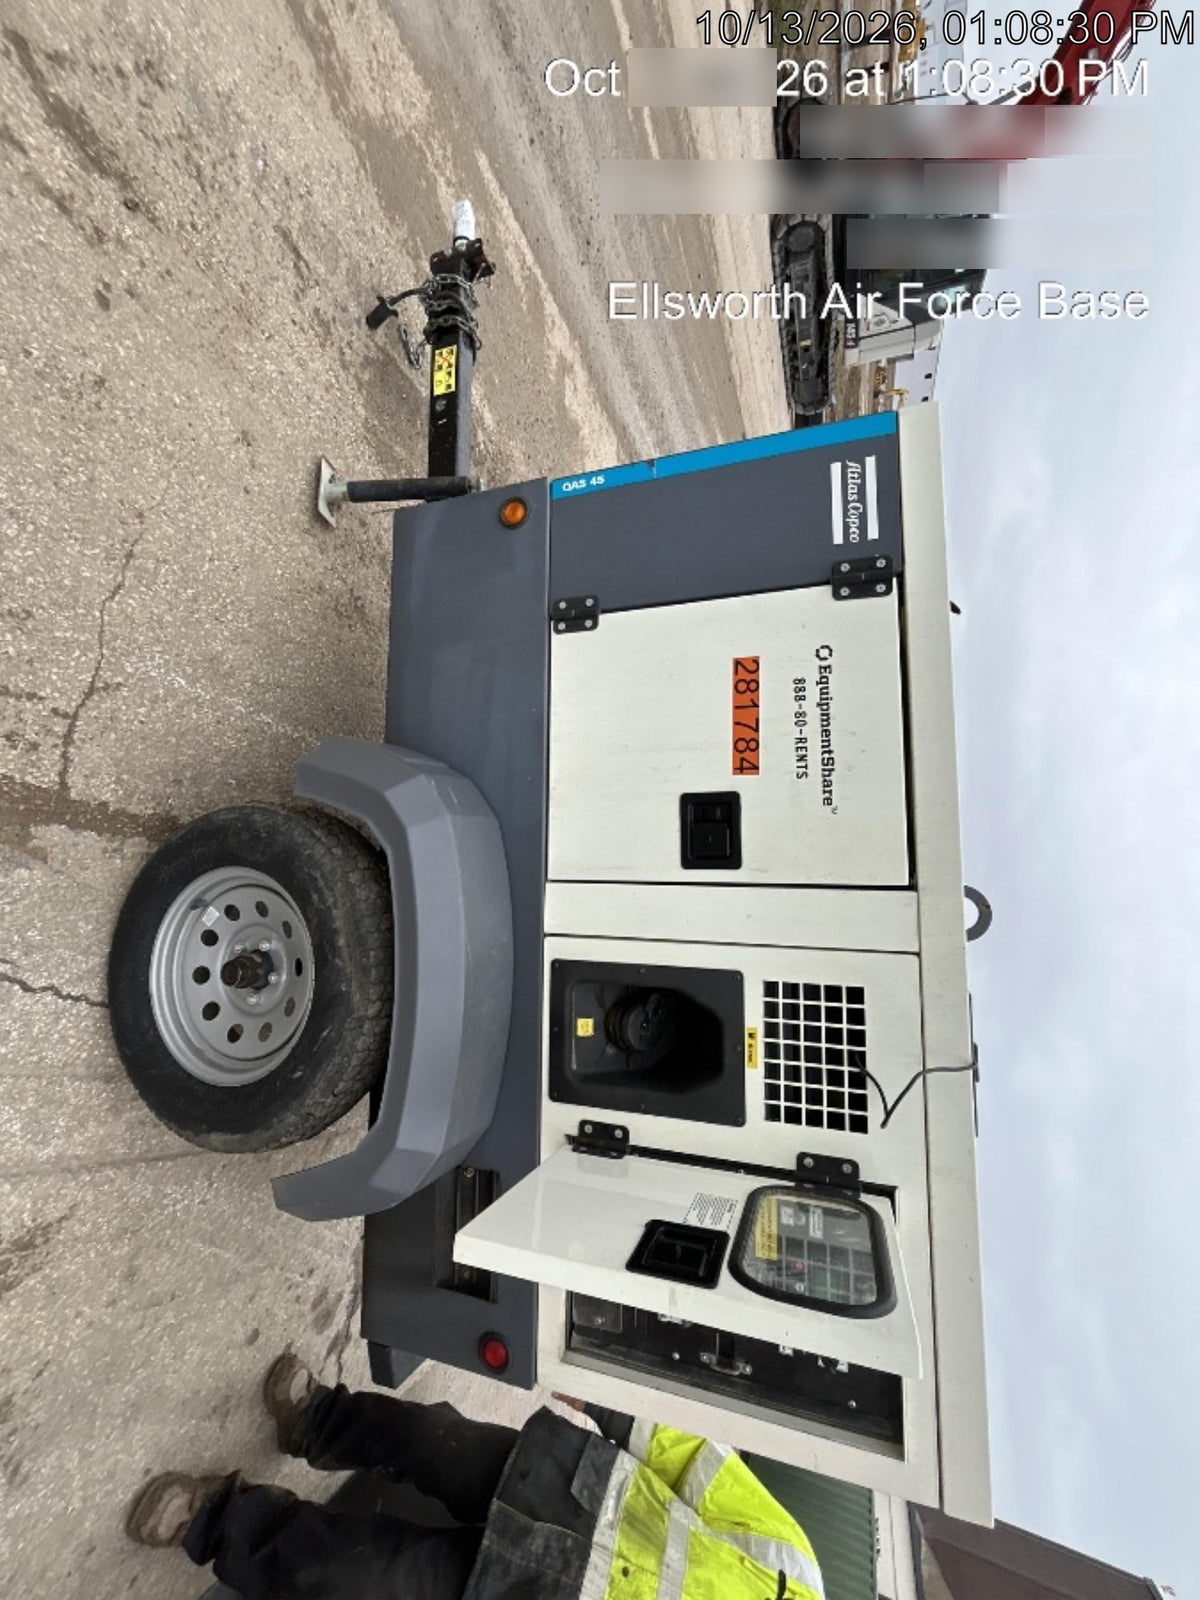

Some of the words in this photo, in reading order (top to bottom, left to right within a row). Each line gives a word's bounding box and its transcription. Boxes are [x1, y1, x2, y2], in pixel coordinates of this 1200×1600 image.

[845, 460, 862, 501] Atlas
[845, 502, 864, 544] Copco
[733, 658, 760, 776] 281784
[792, 677, 808, 780] 888-80-RENTS
